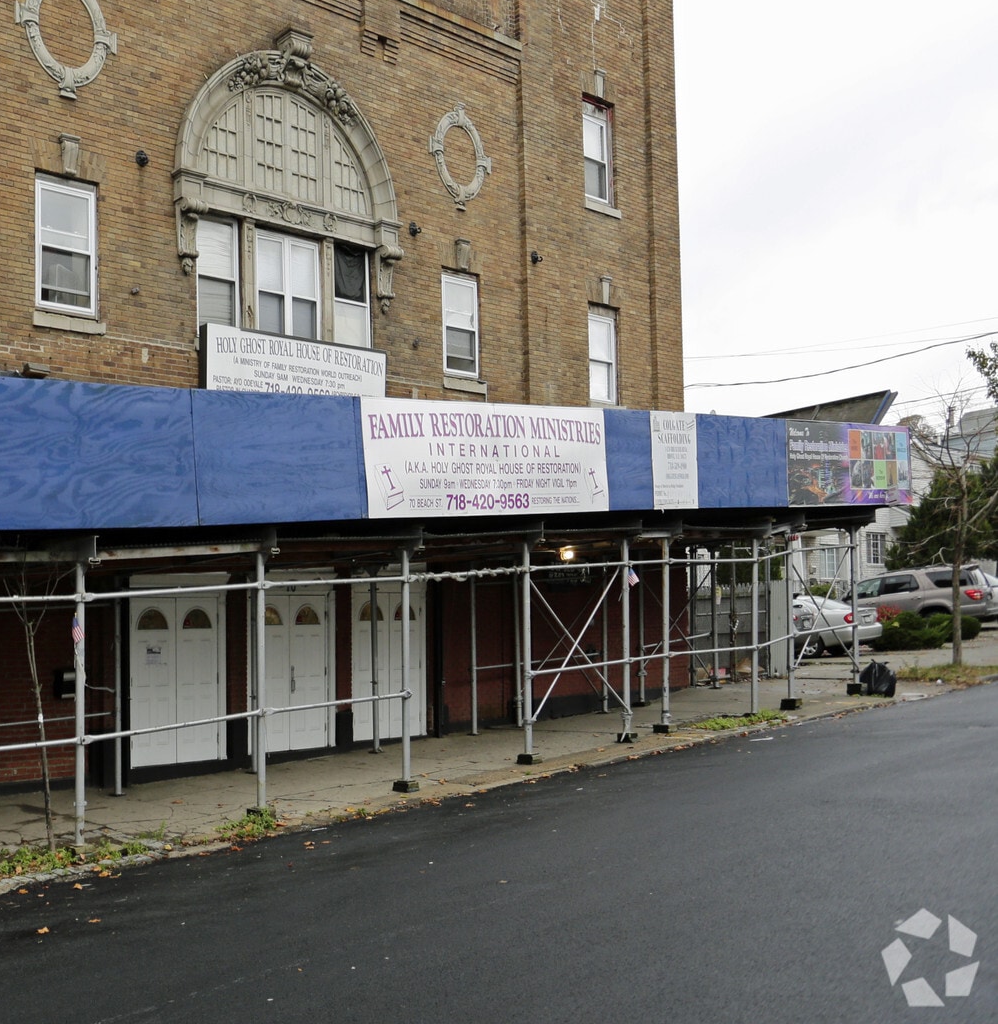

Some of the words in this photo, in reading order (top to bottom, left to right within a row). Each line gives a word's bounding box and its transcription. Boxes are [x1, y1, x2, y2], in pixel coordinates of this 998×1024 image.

[216, 336, 237, 354] HOLY
[240, 337, 267, 355] GHOST
[269, 339, 293, 357] ROYAL
[296, 342, 321, 361] HOUSE
[323, 347, 333, 364] OF
[334, 349, 384, 377] RESTORATION
[240, 357, 262, 368] MINISTRY
[263, 361, 270, 369] OF
[272, 362, 287, 372] FAMILY
[288, 364, 319, 376] RESTORATION
[321, 369, 337, 379] WORLD
[254, 369, 275, 379] SUNDAY
[292, 375, 323, 386] WEDNESDAY
[337, 382, 345, 390] pm
[368, 413, 425, 440] FAMILY
[429, 413, 526, 438] RESTORATION
[529, 416, 601, 445] MINISTRIES
[429, 442, 560, 458] INTERNATIONAL
[405, 461, 428, 474] (A.K.A.
[431, 462, 448, 474] HOLY
[452, 462, 473, 474] GHOST
[476, 462, 497, 475] ROYAL
[499, 463, 523, 475] HOUSE
[526, 463, 535, 474] OF
[537, 462, 581, 474] RESTORATION)
[420, 478, 441, 489] SUNDAY
[444, 479, 455, 489] 9am
[459, 479, 491, 489] WEDNESDAY
[516, 478, 534, 489] FRIDAY
[535, 478, 550, 489] NIGHT
[552, 478, 564, 488] VIGIL
[566, 479, 578, 491] 11pm
[409, 498, 416, 508] 70
[417, 498, 434, 508] BEACH
[446, 493, 530, 511] 718-420-9563
[531, 497, 552, 505] RESTORING
